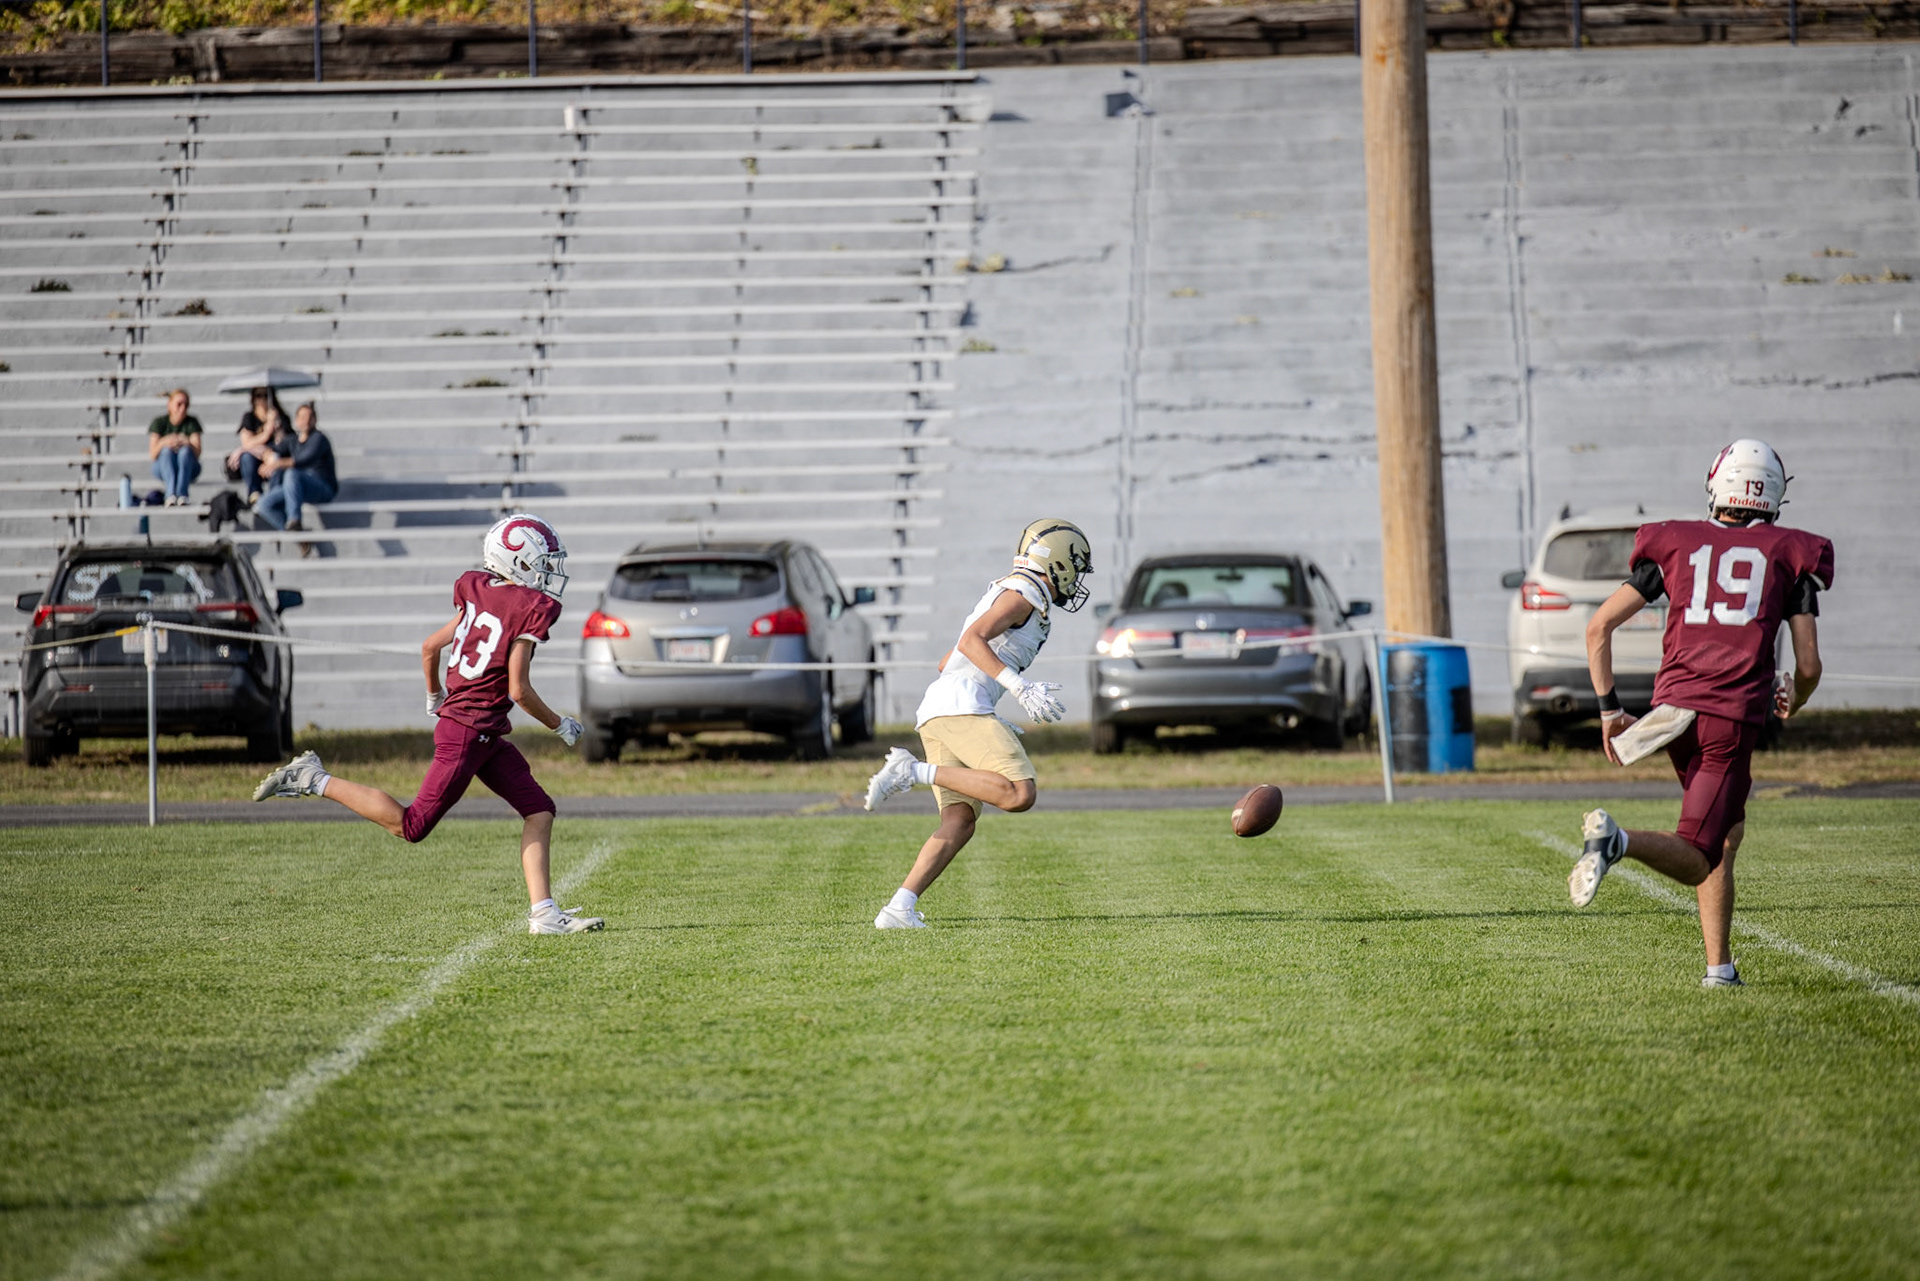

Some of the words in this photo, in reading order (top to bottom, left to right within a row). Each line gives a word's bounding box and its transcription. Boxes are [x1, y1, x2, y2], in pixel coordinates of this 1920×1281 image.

[1746, 480, 1764, 497] 19
[1728, 496, 1770, 510] Riddell
[1684, 544, 1767, 626] 19
